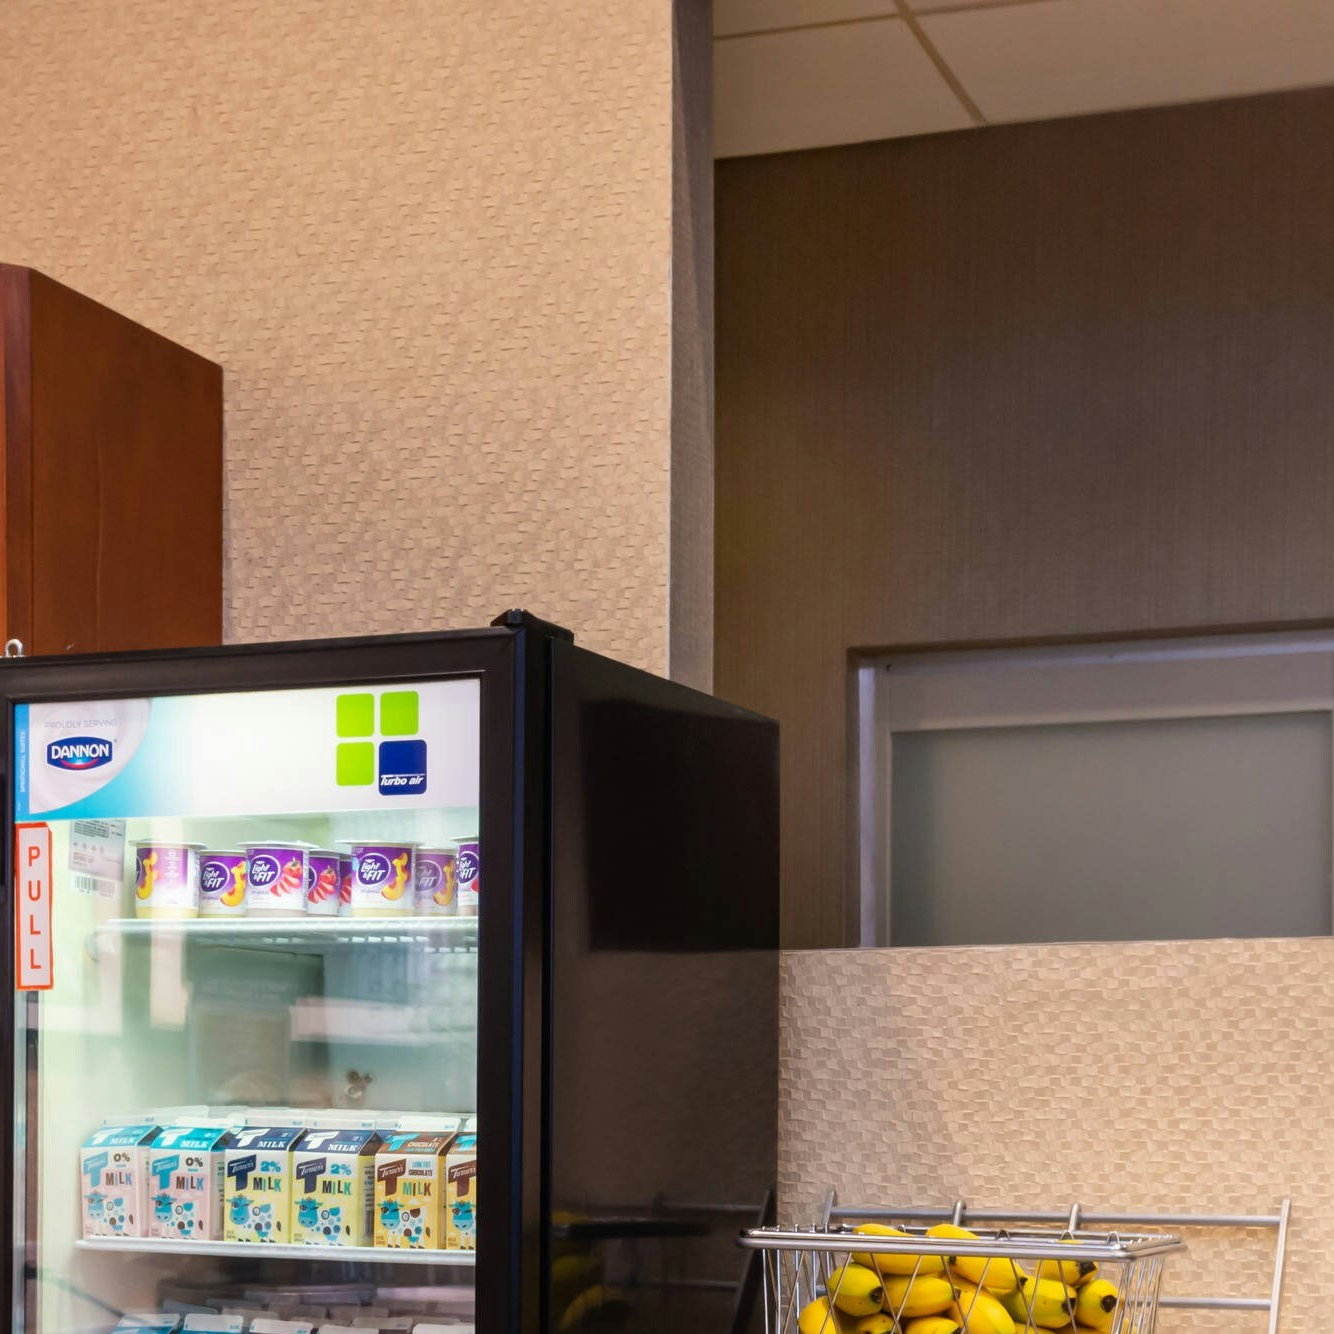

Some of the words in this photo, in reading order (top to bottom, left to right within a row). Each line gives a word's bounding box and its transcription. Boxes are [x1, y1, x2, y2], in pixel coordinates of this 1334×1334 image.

[44, 719, 81, 729] PROUDLY
[51, 744, 109, 760] DANNON
[380, 774, 407, 786] Turbo
[409, 775, 424, 785] air
[361, 862, 380, 872] Light
[27, 845, 42, 970] PULL
[180, 1140, 207, 1148] MILK
[256, 1140, 286, 1148] MILK
[327, 1143, 358, 1152] MILK
[113, 1153, 130, 1162] 0%
[185, 1157, 203, 1167] 0%
[260, 1161, 281, 1172] 2%
[330, 1164, 352, 1176] 2%
[105, 1172, 133, 1186] MILK
[176, 1176, 204, 1191] MILK
[253, 1177, 282, 1192] MILK
[322, 1180, 352, 1195] MILK
[402, 1181, 432, 1197] MILK
